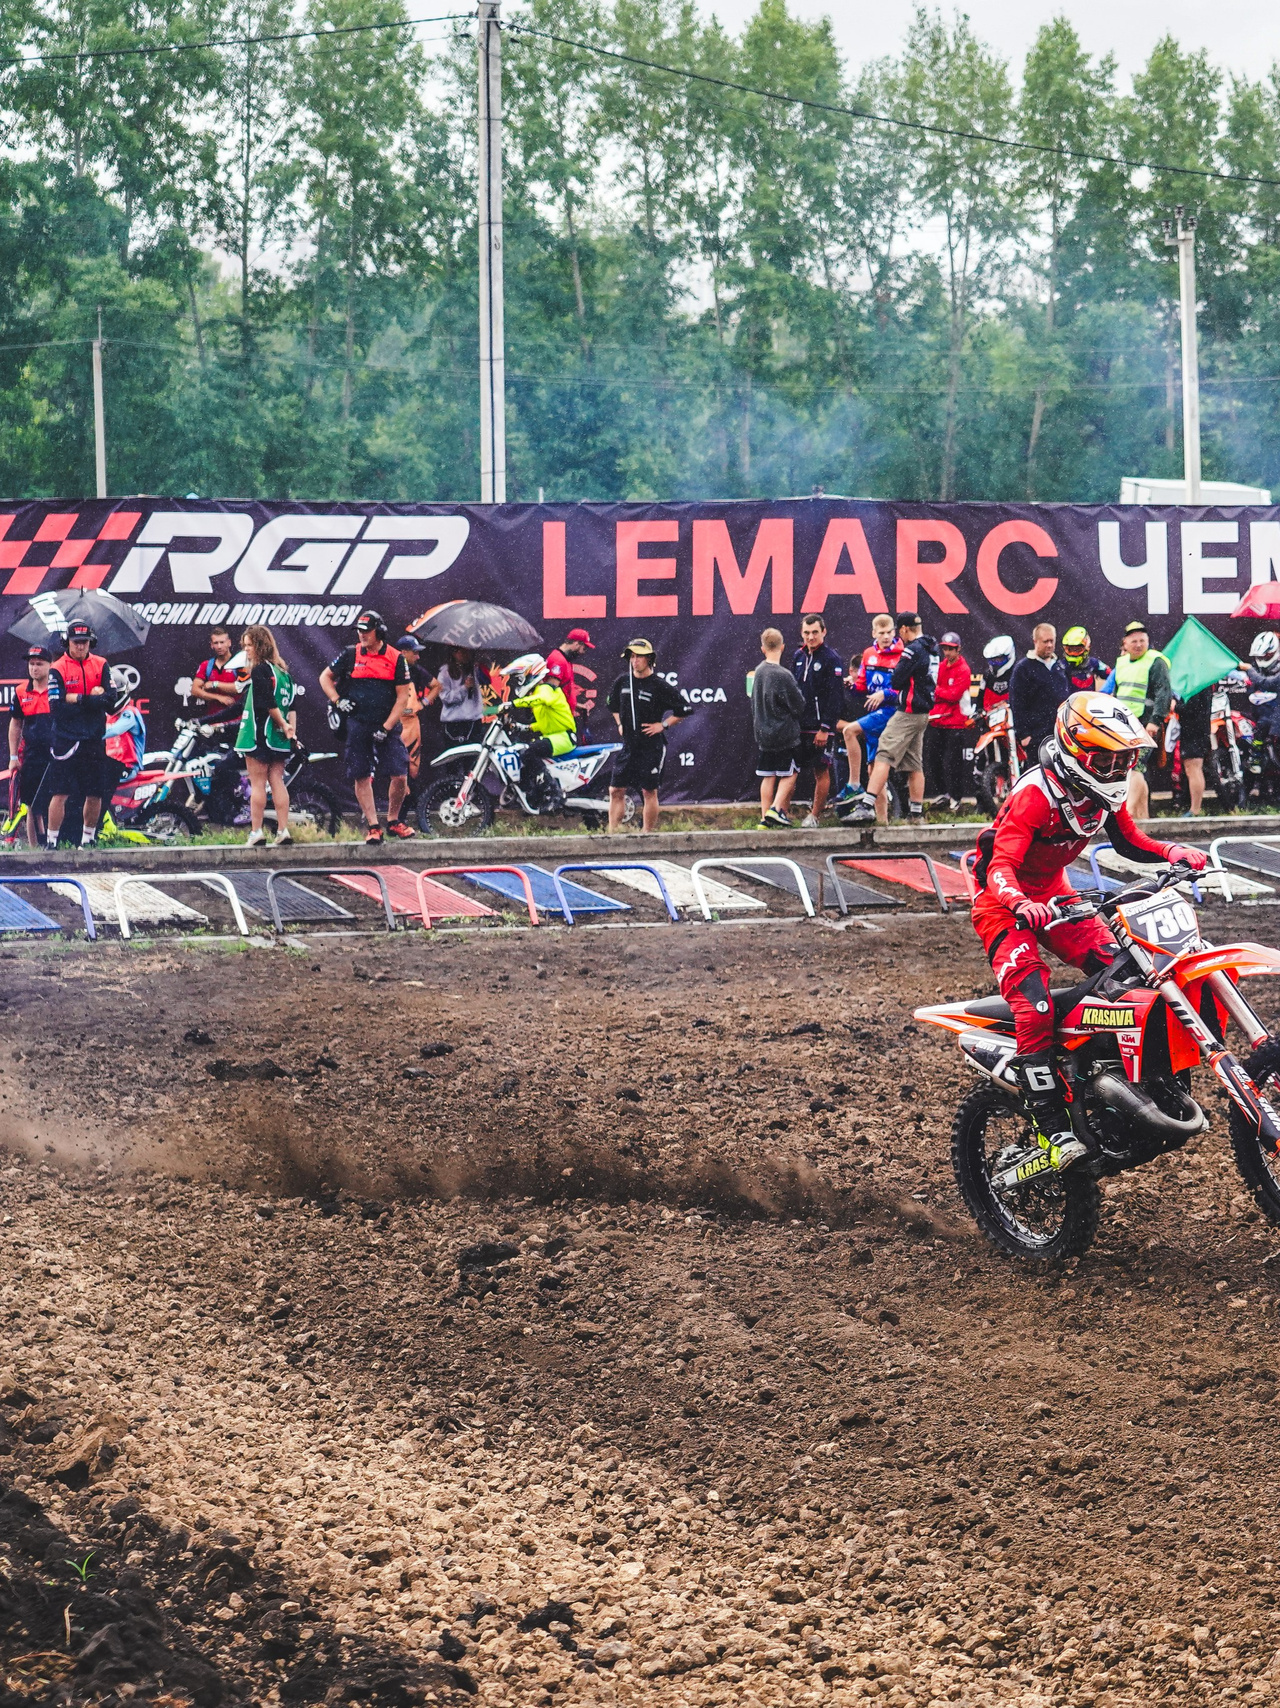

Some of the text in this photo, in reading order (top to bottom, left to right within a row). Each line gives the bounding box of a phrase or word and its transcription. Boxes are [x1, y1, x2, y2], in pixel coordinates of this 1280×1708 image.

[108, 512, 471, 595] RGP
[542, 518, 1058, 619] LEMARC
[194, 602, 230, 625] ПО
[225, 603, 363, 627] МОТОКРОССУ
[679, 752, 695, 767] 12
[1136, 901, 1198, 943] 730
[1081, 1008, 1135, 1026] KRASAVA
